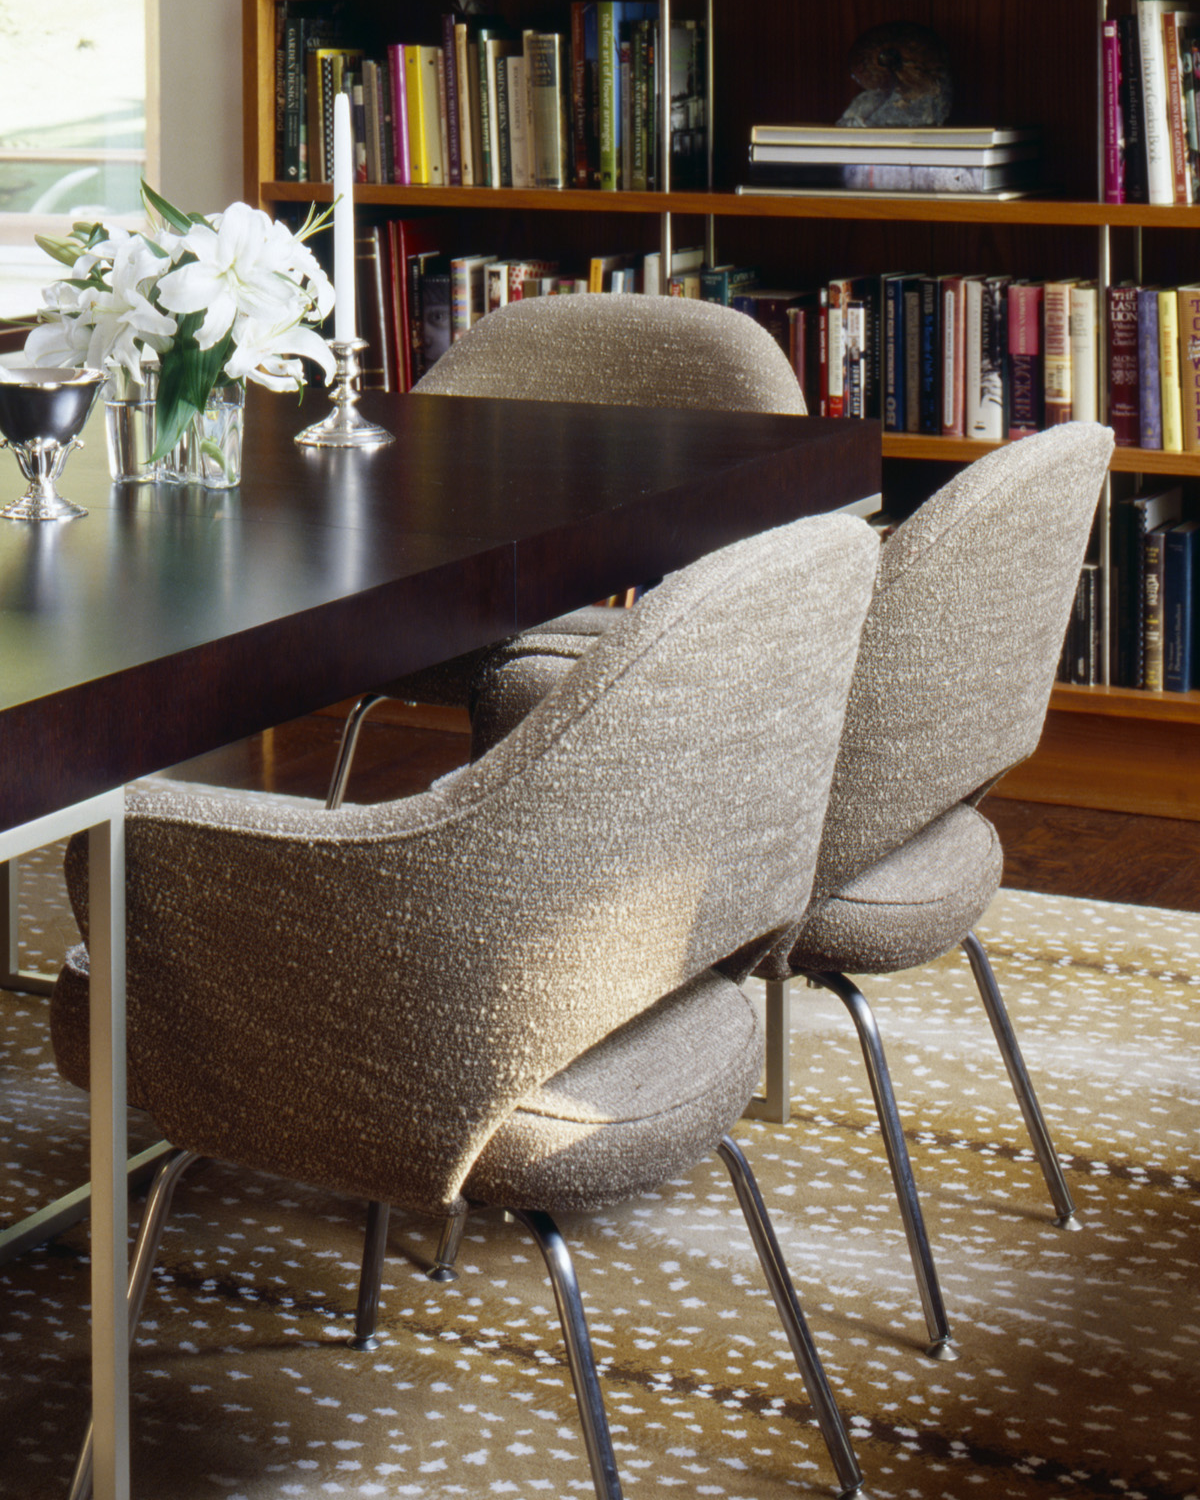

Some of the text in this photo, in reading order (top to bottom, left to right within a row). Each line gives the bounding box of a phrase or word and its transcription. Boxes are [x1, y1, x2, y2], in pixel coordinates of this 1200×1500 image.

[1167, 26, 1175, 41] KEN
[287, 28, 295, 109] GARDEN DESIGN
[601, 13, 612, 153] the fine art of flower arranging
[498, 93, 507, 129] GARDEN
[1128, 78, 1139, 143] Landscaping
[1143, 58, 1160, 164] Indoor Garden Book
[1170, 83, 1179, 113] PASSION
[1172, 114, 1180, 129] FOR
[1173, 131, 1183, 175] GARDENING
[1046, 292, 1064, 313] LIFE
[1110, 302, 1138, 312] LAST
[1112, 291, 1136, 301] THE
[1110, 311, 1138, 322] LION
[852, 365, 860, 383] JOHN
[1013, 354, 1031, 416] JACKIE
